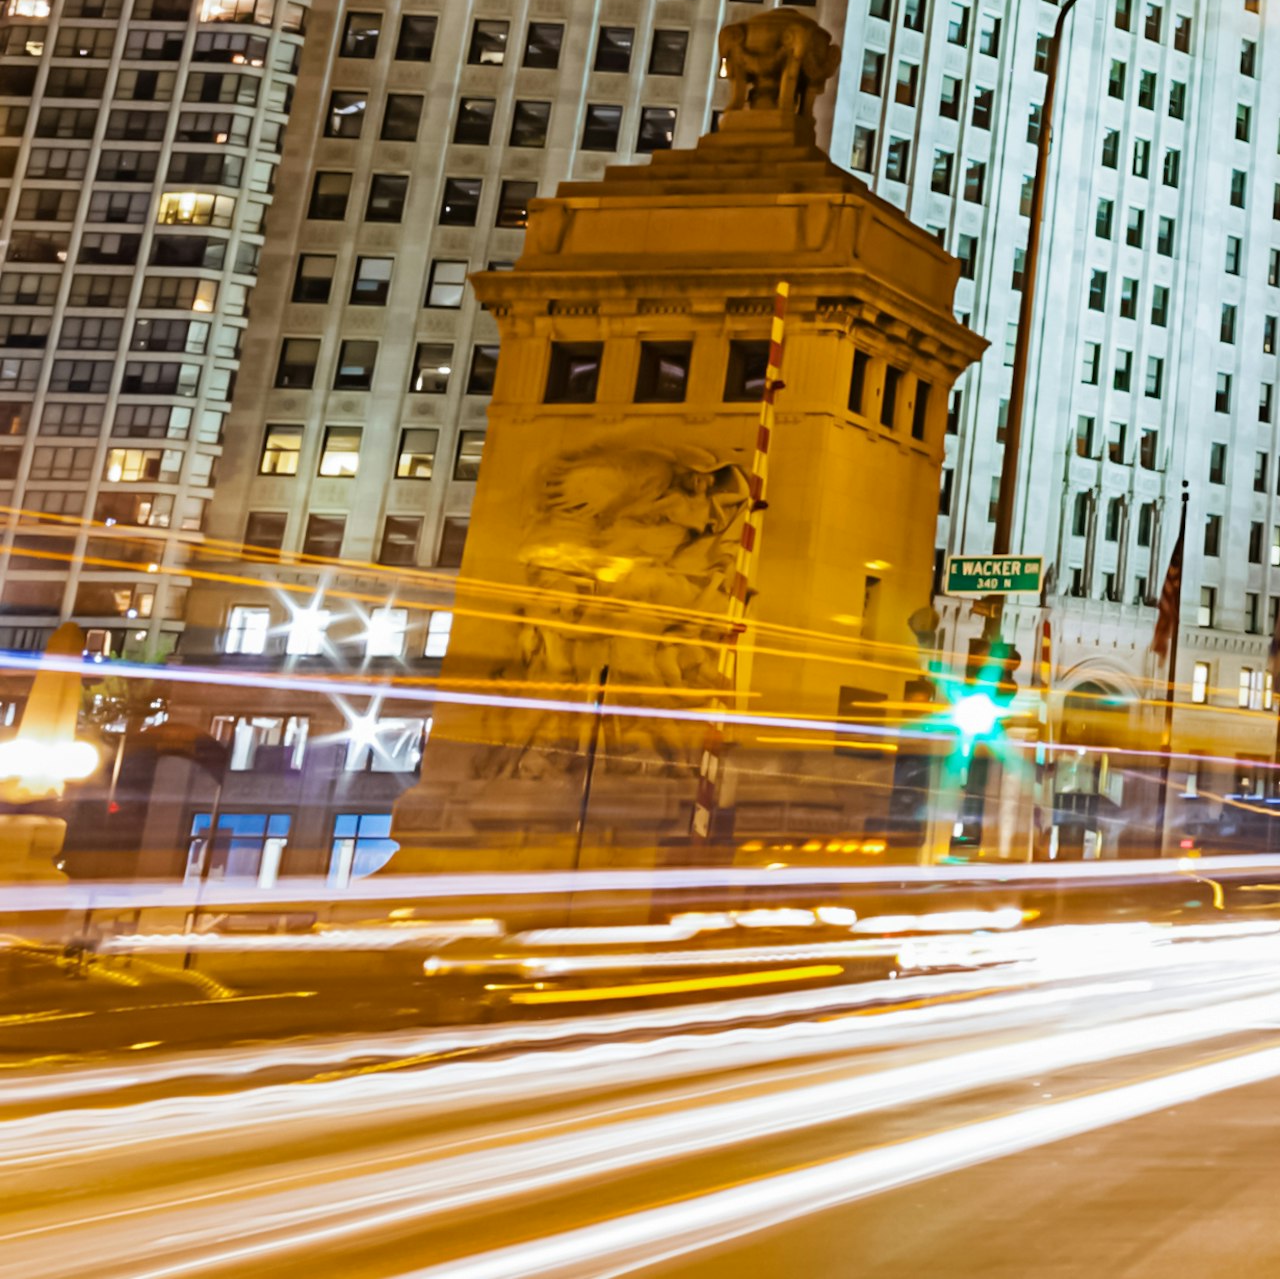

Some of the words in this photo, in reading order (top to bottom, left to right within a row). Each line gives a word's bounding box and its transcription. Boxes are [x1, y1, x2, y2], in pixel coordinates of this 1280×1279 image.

[951, 563, 958, 574] E
[962, 560, 1022, 576] WACKER
[1024, 562, 1039, 574] DR
[976, 578, 999, 589] 340
[1003, 578, 1012, 588] N
